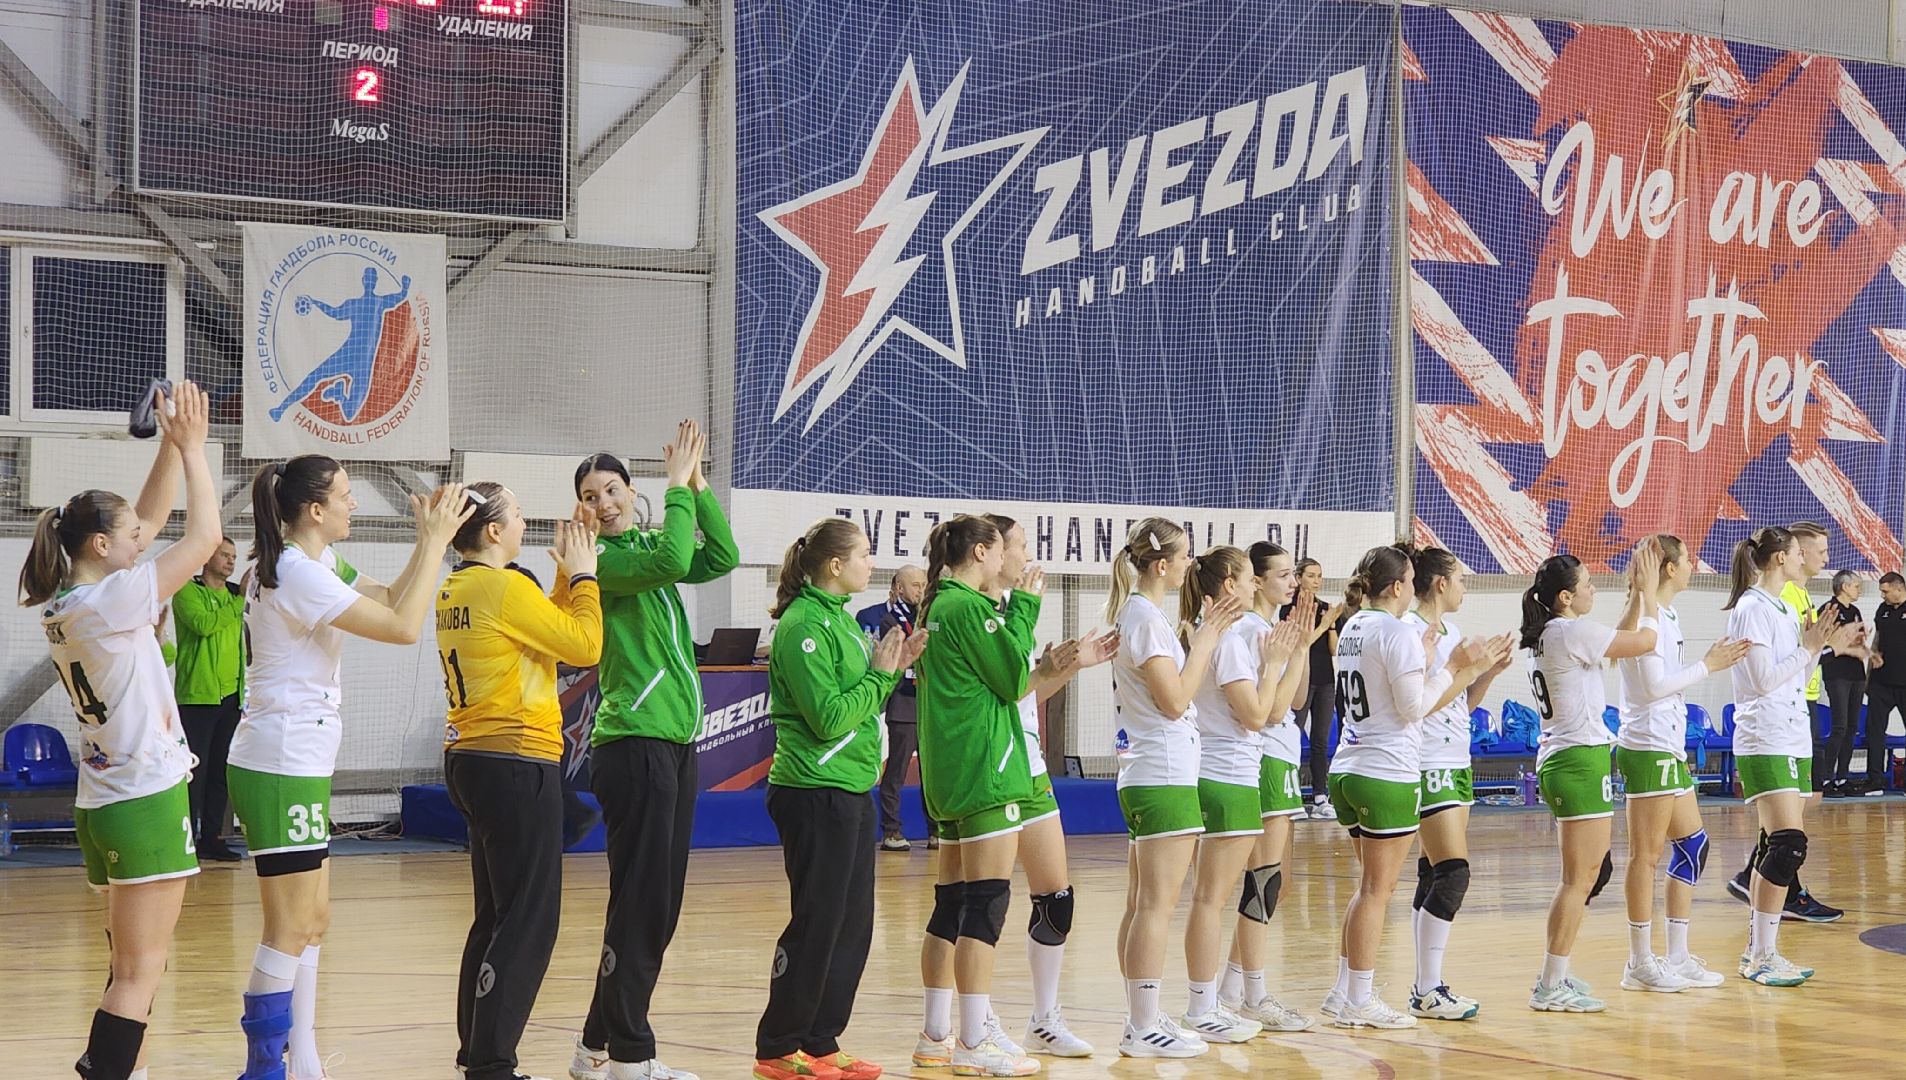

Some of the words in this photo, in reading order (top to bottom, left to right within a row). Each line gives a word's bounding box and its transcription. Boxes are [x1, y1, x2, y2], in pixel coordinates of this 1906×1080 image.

[437, 15, 533, 40] УДАЛЕНИЯ
[321, 39, 400, 68] ПЕРИОД
[354, 69, 379, 103] 2
[329, 118, 390, 143] MegaS
[1020, 65, 1369, 275] ZVEZDA
[1539, 120, 1689, 258] We
[1708, 168, 1836, 249] are
[1014, 231, 1238, 330] HANDBALL
[1270, 184, 1364, 242] CLUB
[257, 289, 278, 394] ФЕДЕРАЦИЯ
[269, 234, 335, 289] ГАНДБОЛА
[339, 232, 397, 266] РОССИИ
[292, 410, 365, 445] HANDBALL
[367, 376, 424, 443] FEDERATION
[419, 353, 431, 373] OF
[1425, 768, 1454, 793] 84
[287, 802, 325, 843] 35
